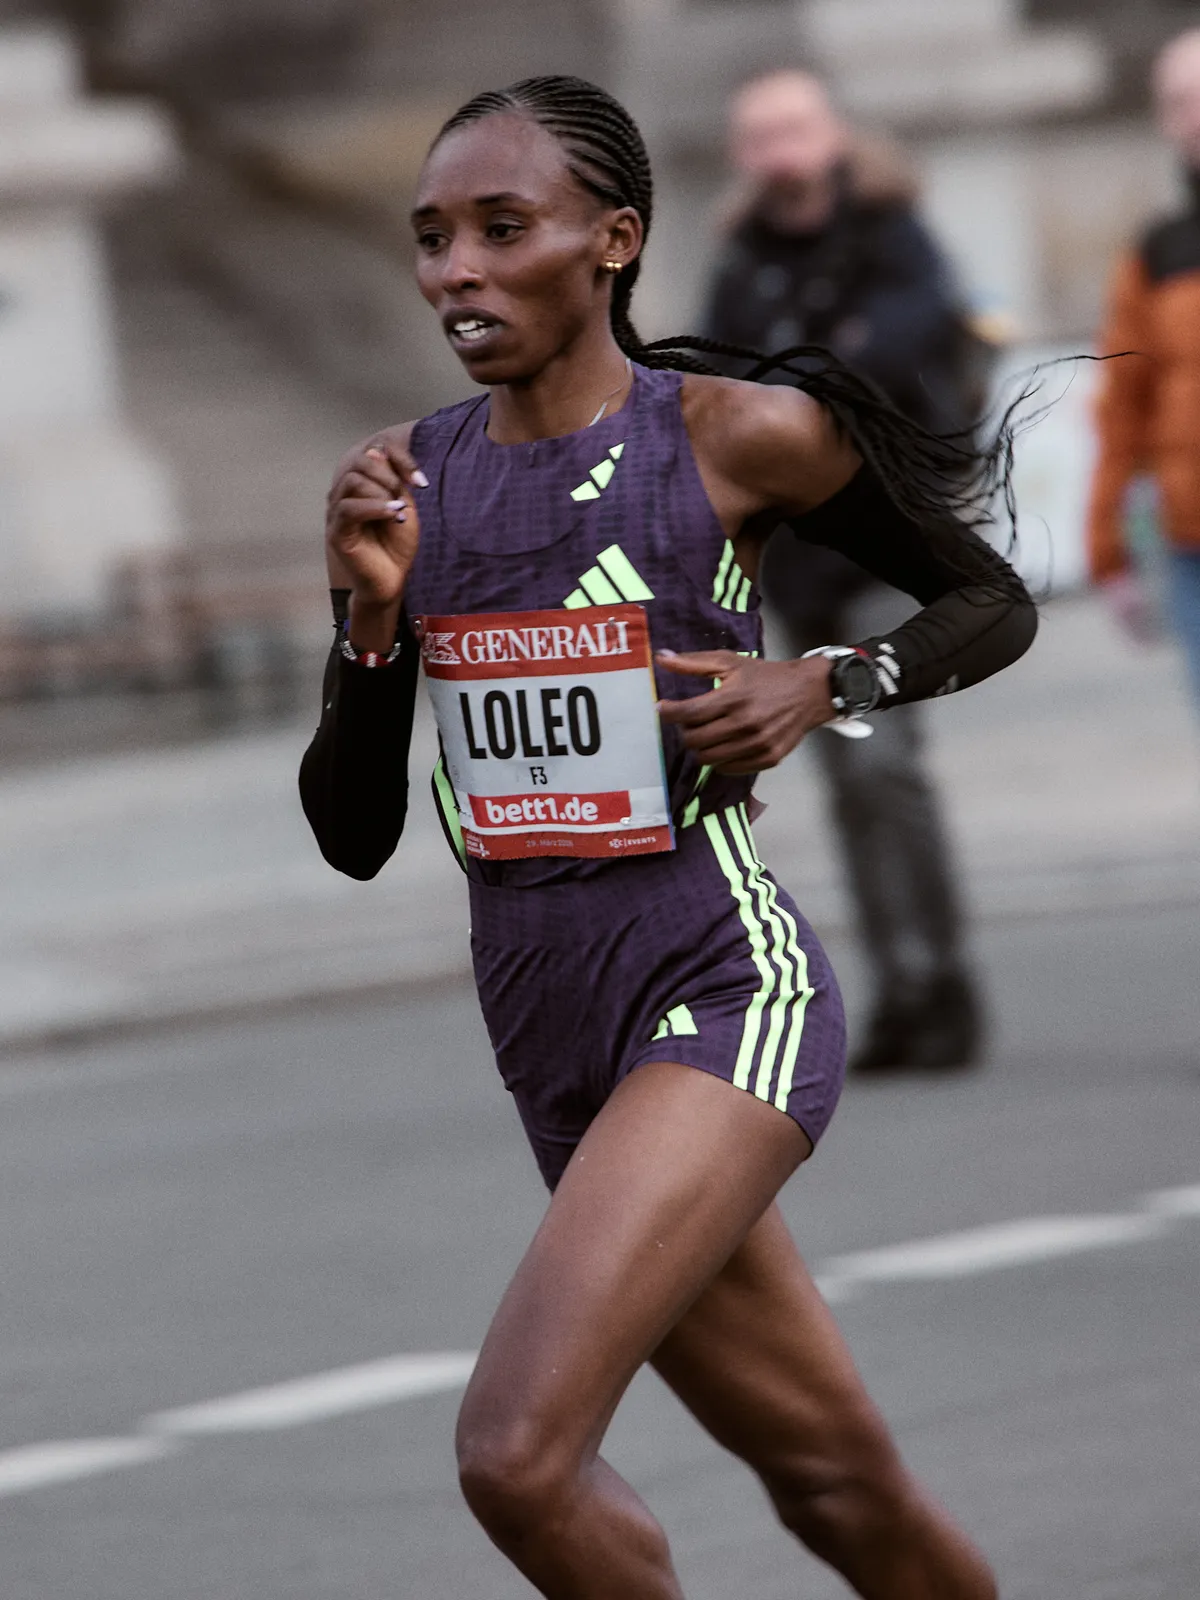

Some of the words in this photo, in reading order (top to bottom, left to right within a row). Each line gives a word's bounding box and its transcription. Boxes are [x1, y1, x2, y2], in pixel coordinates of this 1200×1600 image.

[461, 621, 632, 664] GENERALI
[459, 686, 602, 760] LOLEO
[530, 766, 548, 785] F3
[485, 797, 598, 825] bett1.de
